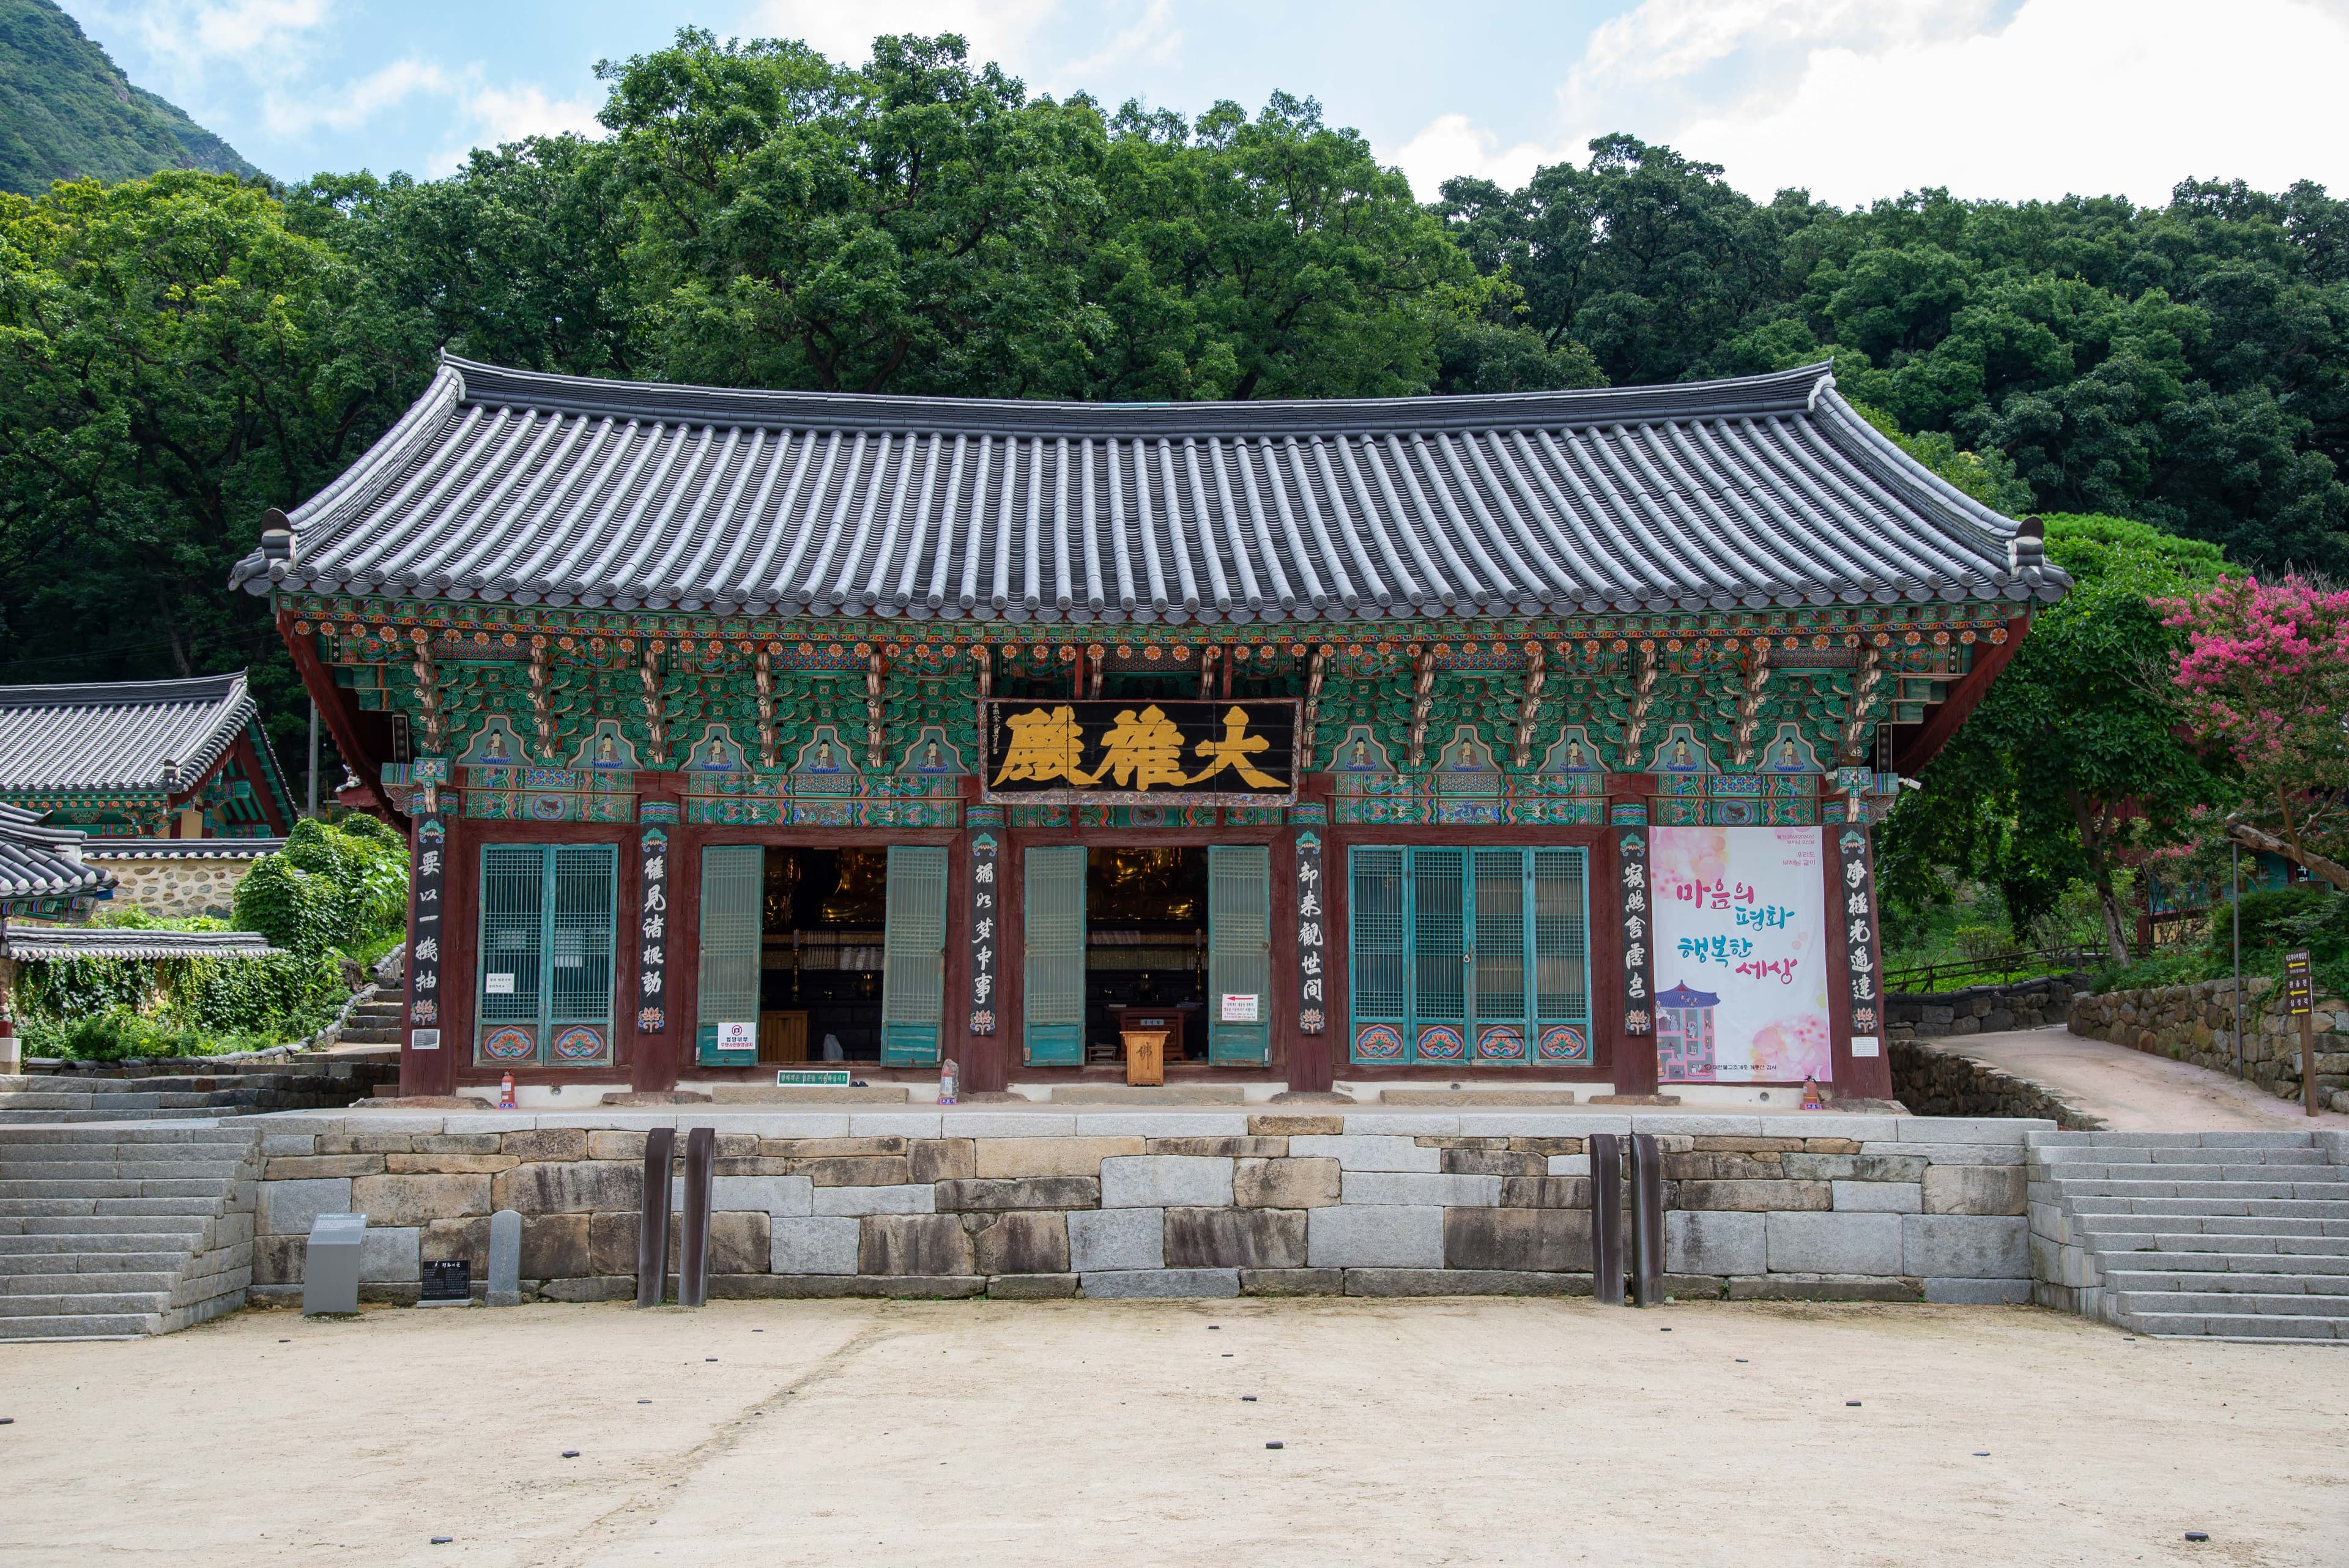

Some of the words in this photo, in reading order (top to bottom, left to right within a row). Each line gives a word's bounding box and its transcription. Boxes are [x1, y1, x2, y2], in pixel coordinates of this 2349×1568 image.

[990, 704, 1291, 792] 大雄殿
[1676, 878, 1754, 910] 마음의
[1734, 905, 1795, 931] 평화
[1677, 934, 1753, 968] 행복한
[1735, 958, 1798, 985] 세상
[1135, 1041, 1152, 1070] 佛
